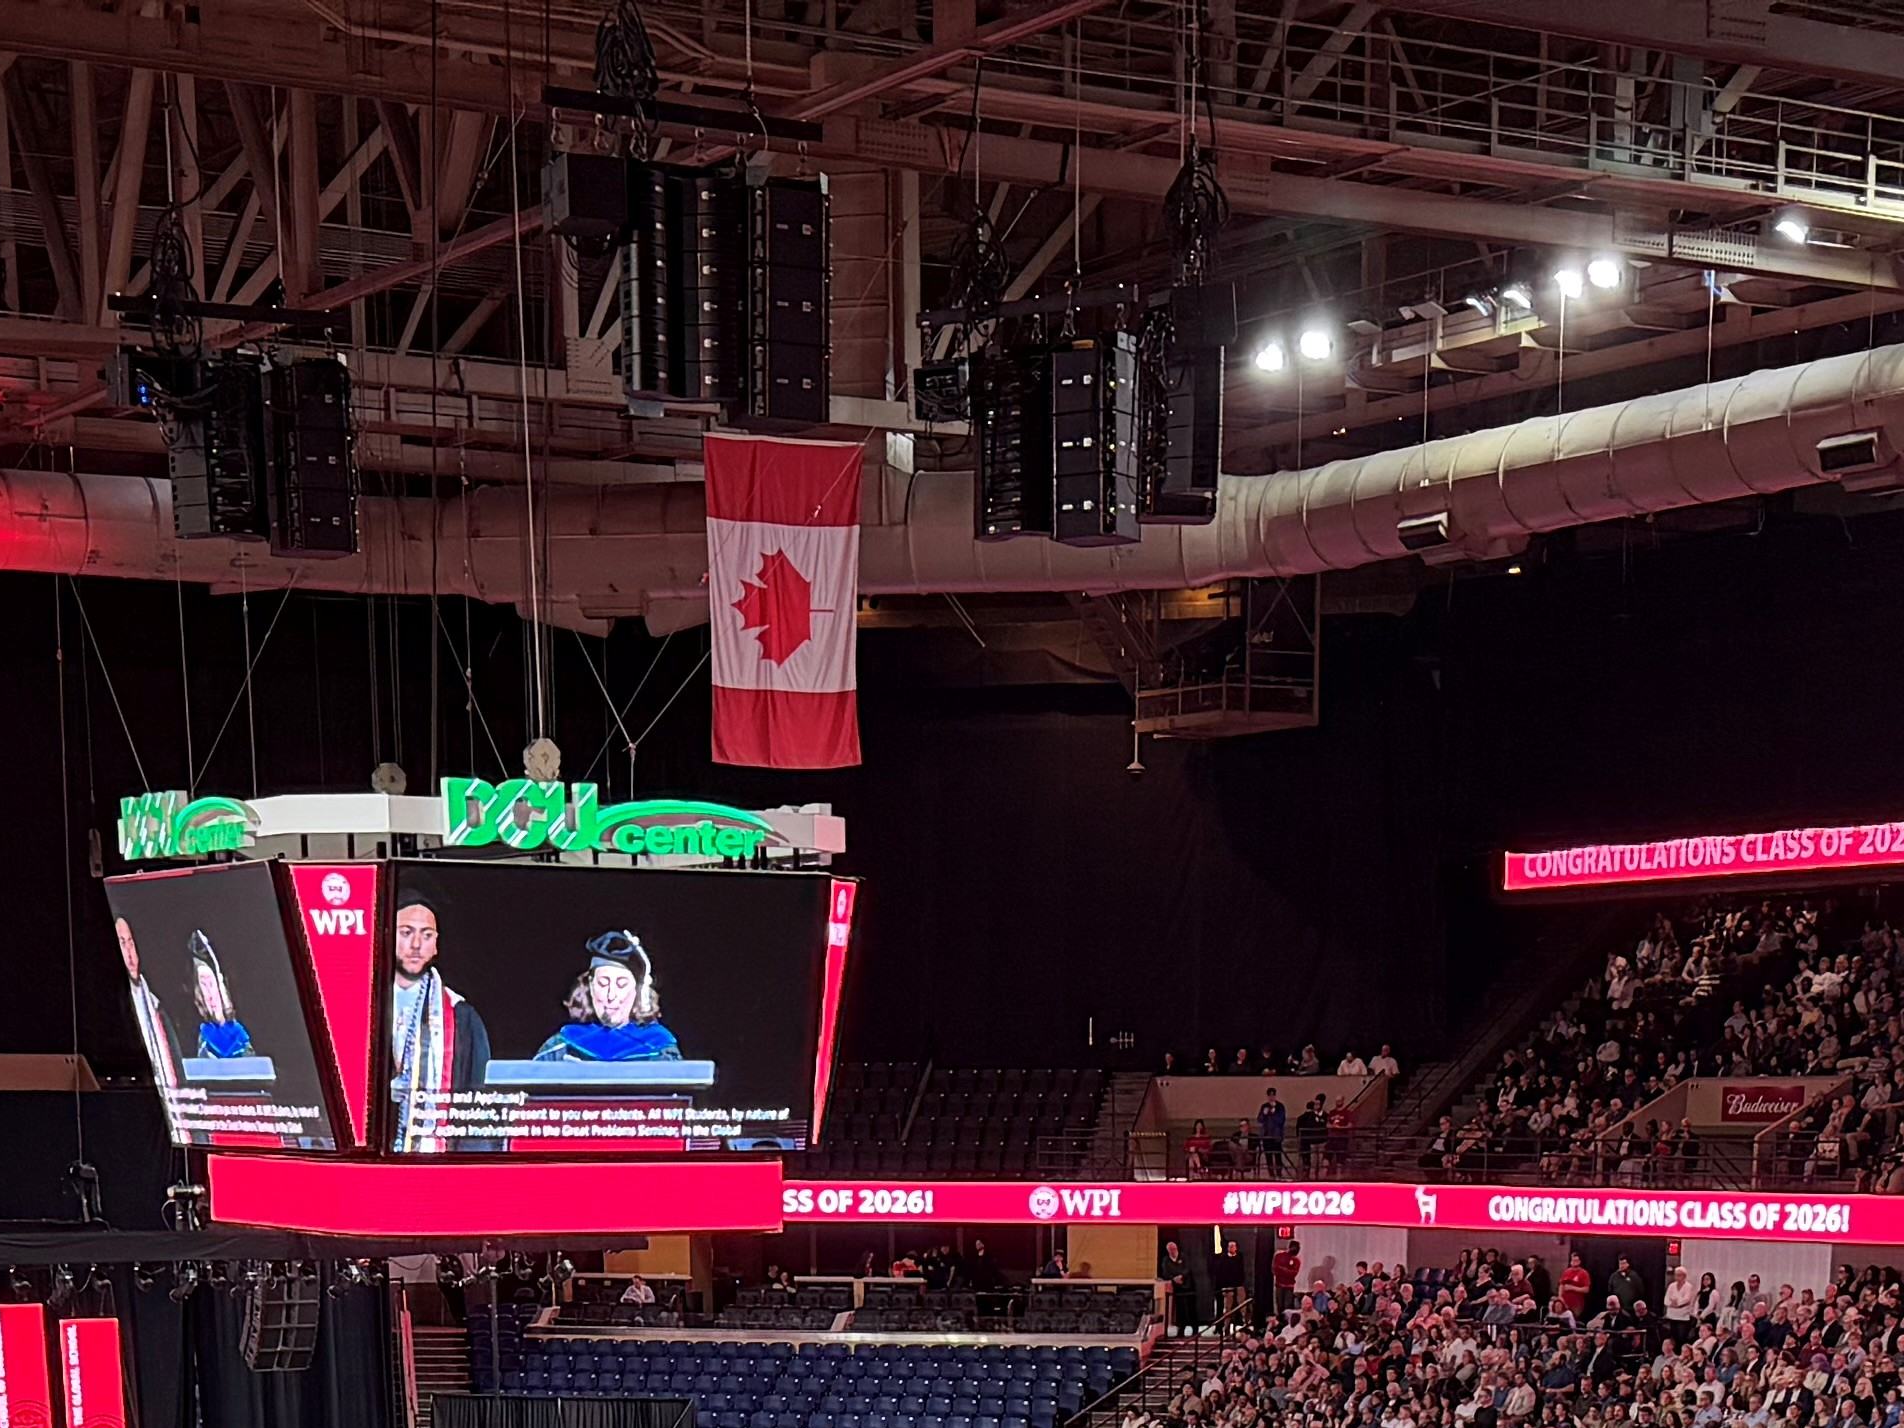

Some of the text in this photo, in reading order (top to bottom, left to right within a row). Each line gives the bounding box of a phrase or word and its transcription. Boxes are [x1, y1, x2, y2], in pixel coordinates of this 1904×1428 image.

[442, 776, 766, 860] DCU center
[1524, 836, 1736, 879] CONGRATULATIONS
[1740, 829, 1811, 863] CLASS
[1821, 826, 1853, 856] OF
[309, 908, 368, 936] WPI
[1727, 1093, 1799, 1116] Budweiser
[816, 1189, 853, 1214] OF
[858, 1188, 934, 1214] 2026!
[1060, 1189, 1122, 1217] WPI
[1222, 1190, 1356, 1216] #WPI2026
[1488, 1194, 1850, 1233] CONGRATULATIONS CLASS OF 2026!
[67, 1324, 84, 1427] THE GLOBAL SCHOOL
